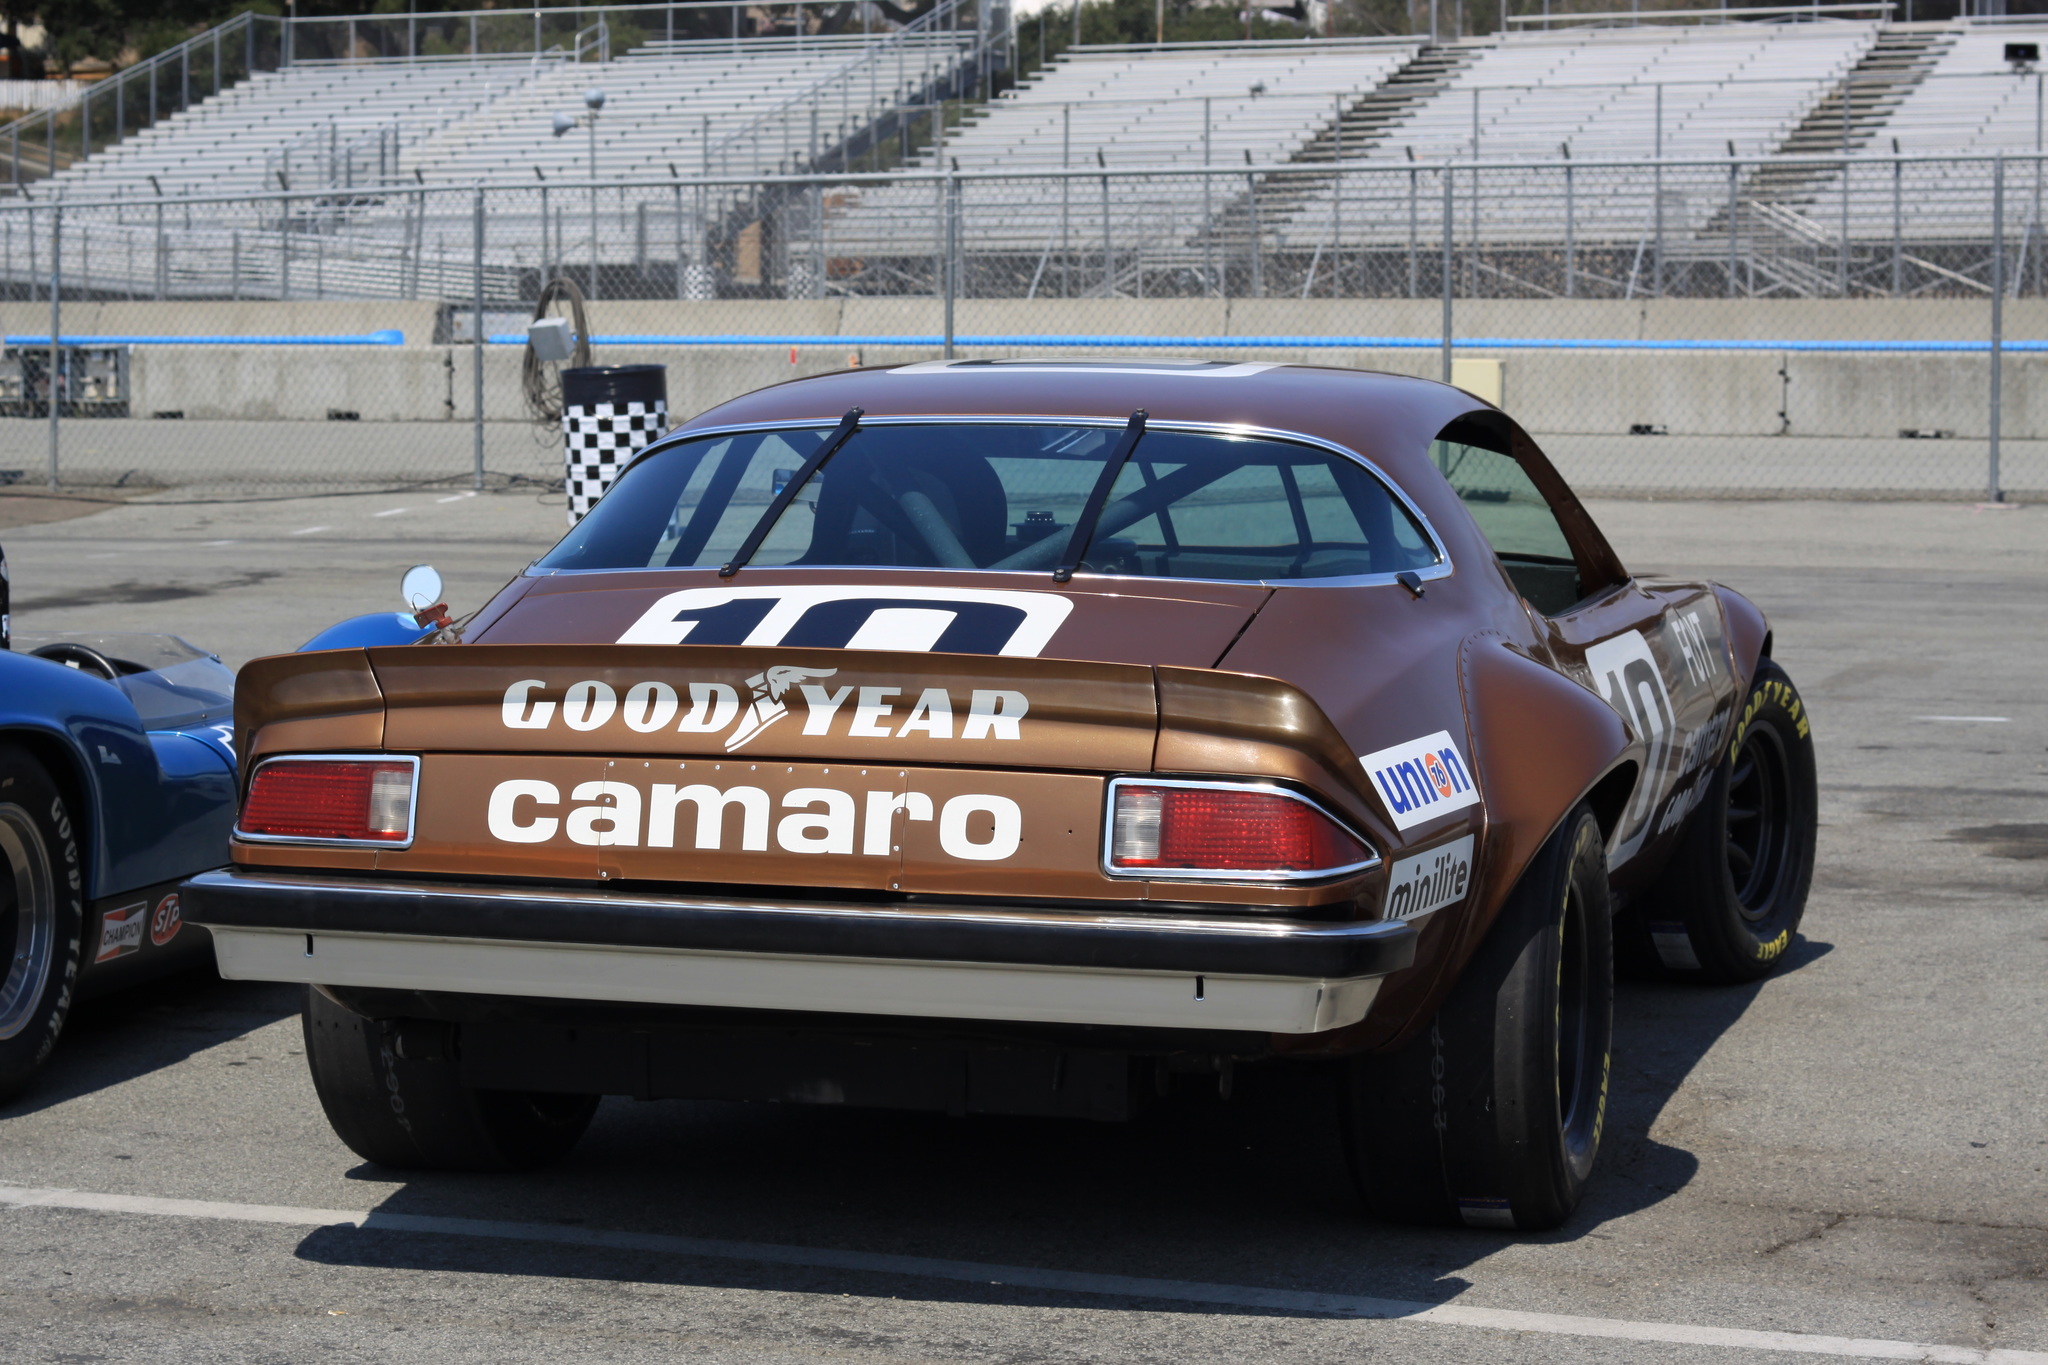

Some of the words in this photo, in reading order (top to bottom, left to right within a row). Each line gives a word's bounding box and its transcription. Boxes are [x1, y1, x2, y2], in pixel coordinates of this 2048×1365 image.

[1677, 706, 1731, 778] camar
[1375, 747, 1471, 815] union
[487, 778, 1022, 861] camaro
[154, 899, 180, 933] STP
[1387, 852, 1468, 919] minilite
[103, 921, 141, 946] CHAMPION
[1756, 928, 1788, 960] EAGLE
